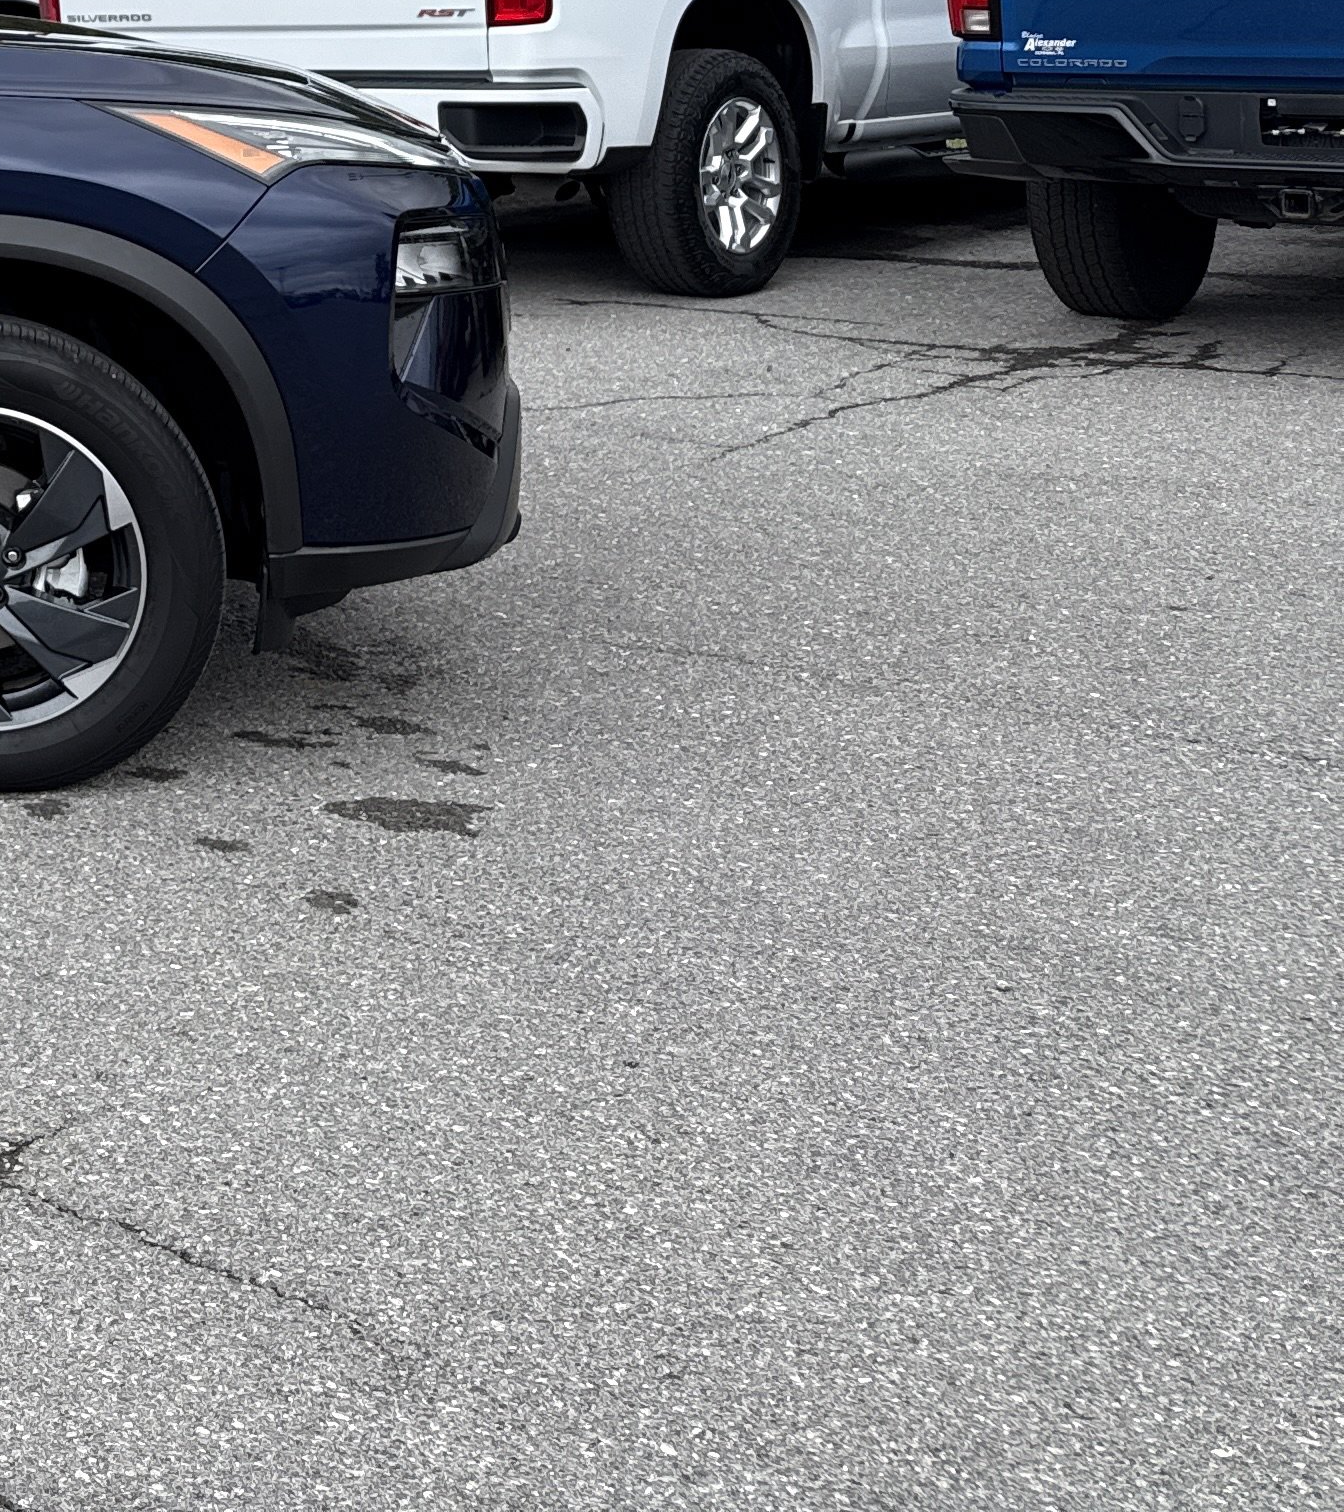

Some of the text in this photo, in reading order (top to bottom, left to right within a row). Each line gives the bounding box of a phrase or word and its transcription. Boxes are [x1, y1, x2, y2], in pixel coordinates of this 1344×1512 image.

[65, 13, 153, 23] SILVERADO
[415, 7, 476, 19] RST
[1023, 38, 1077, 52] Alexander
[1016, 58, 1128, 68] COLORADO
